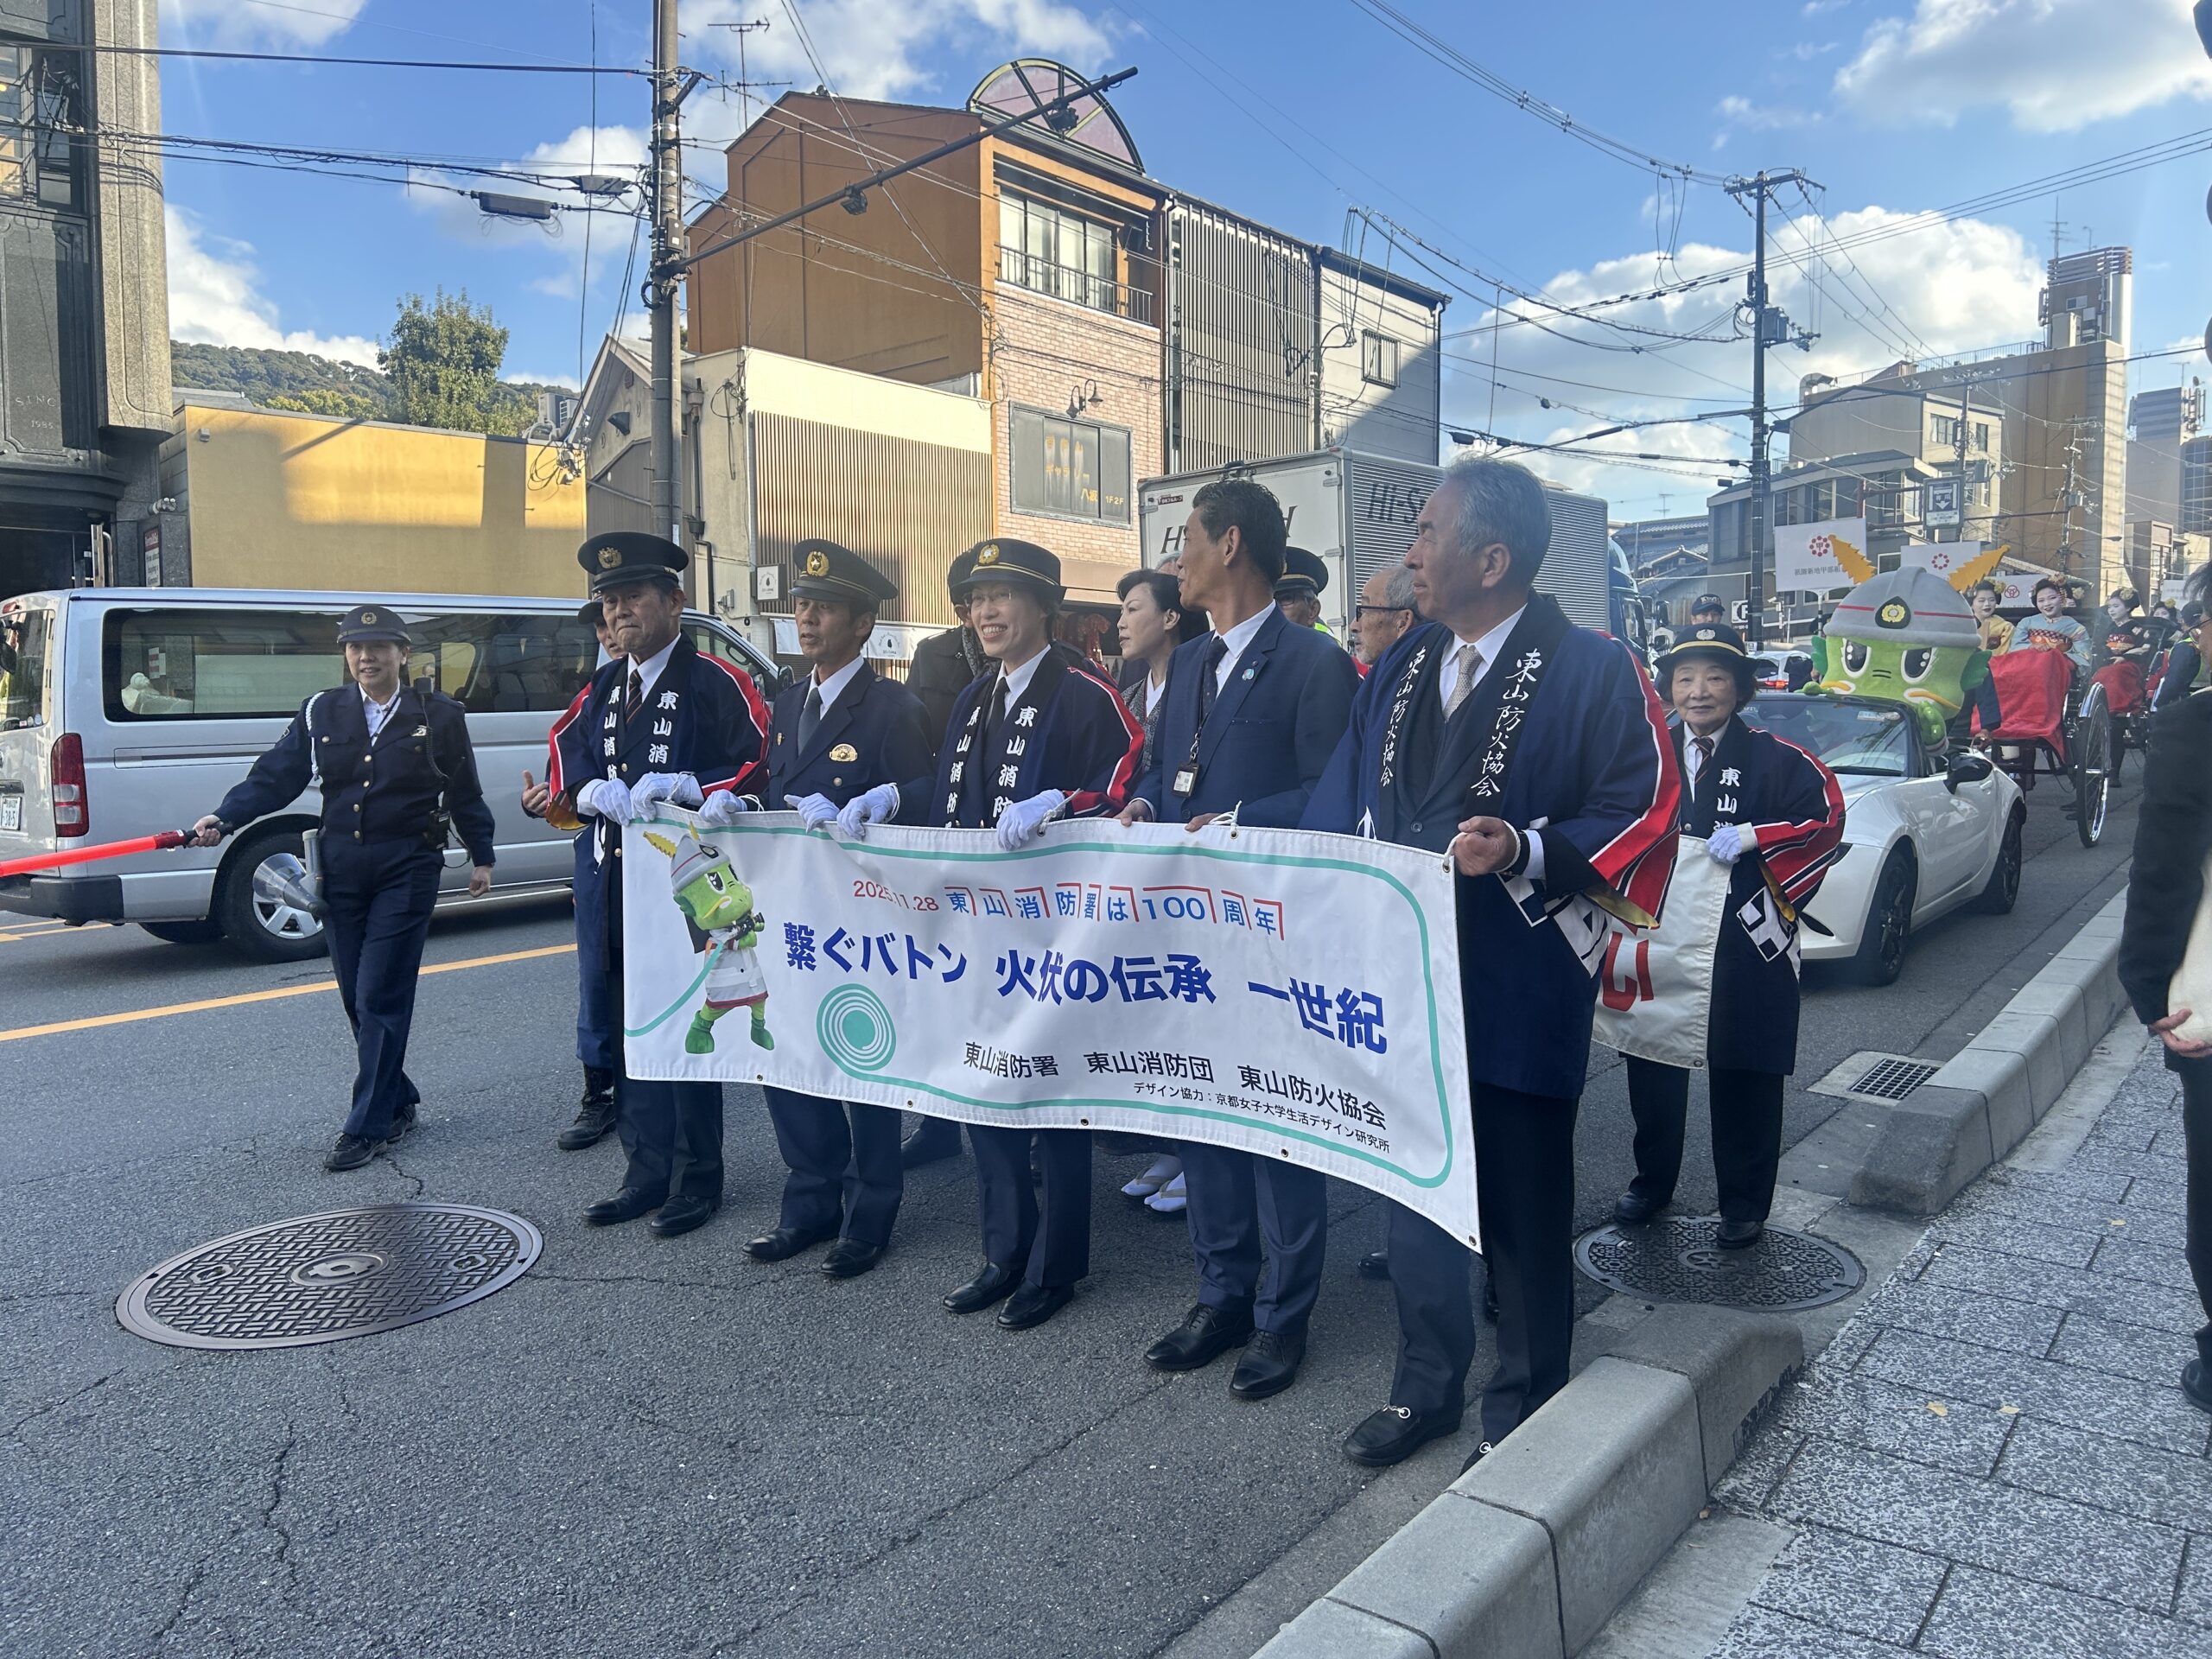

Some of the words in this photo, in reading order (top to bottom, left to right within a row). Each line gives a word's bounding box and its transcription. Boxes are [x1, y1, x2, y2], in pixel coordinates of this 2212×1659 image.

[15, 395, 57, 407] SINC
[648, 690, 679, 774] 東山消
[1380, 645, 1427, 787] 東山防火協会
[1470, 648, 1542, 797] 東山防火協会
[783, 921, 968, 983] 繋ぐバトン
[995, 949, 1217, 1006] 火伏の伝承
[1248, 976, 1389, 1055] 一世紀
[963, 1042, 1058, 1078] 東山消防署
[1084, 1051, 1215, 1084] 東山消防団
[1238, 1065, 1387, 1131] 東山防火協会
